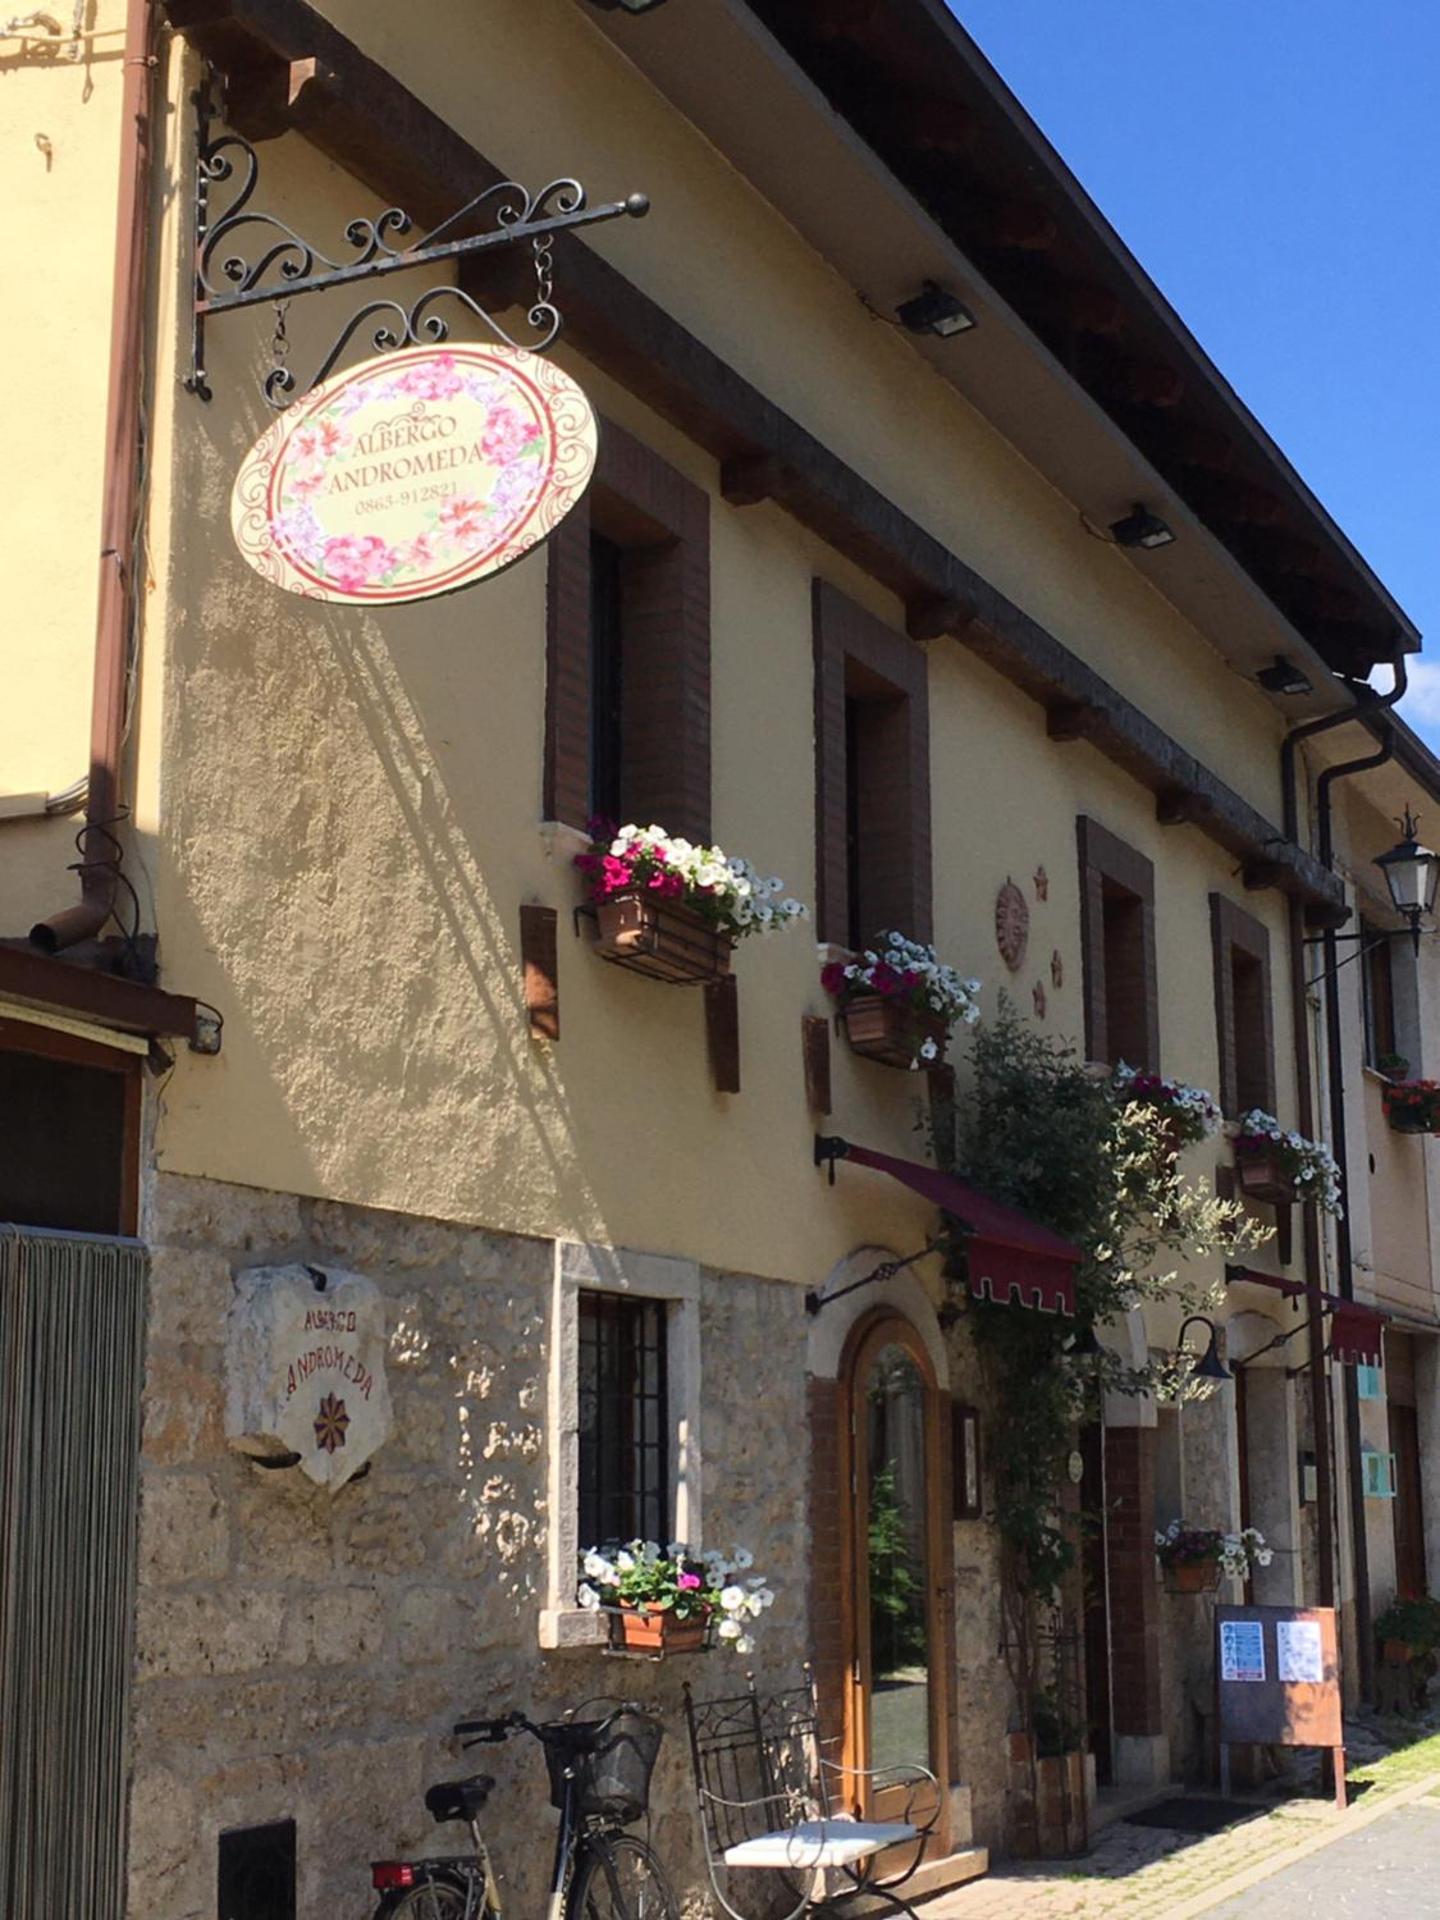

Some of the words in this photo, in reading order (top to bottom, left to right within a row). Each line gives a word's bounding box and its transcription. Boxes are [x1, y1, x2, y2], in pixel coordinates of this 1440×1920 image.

[352, 415, 458, 458] ALBERGO
[328, 441, 484, 495] ANDROMEDA
[354, 481, 459, 516] 0863-912821
[287, 1346, 374, 1401] ANDROMEDA
